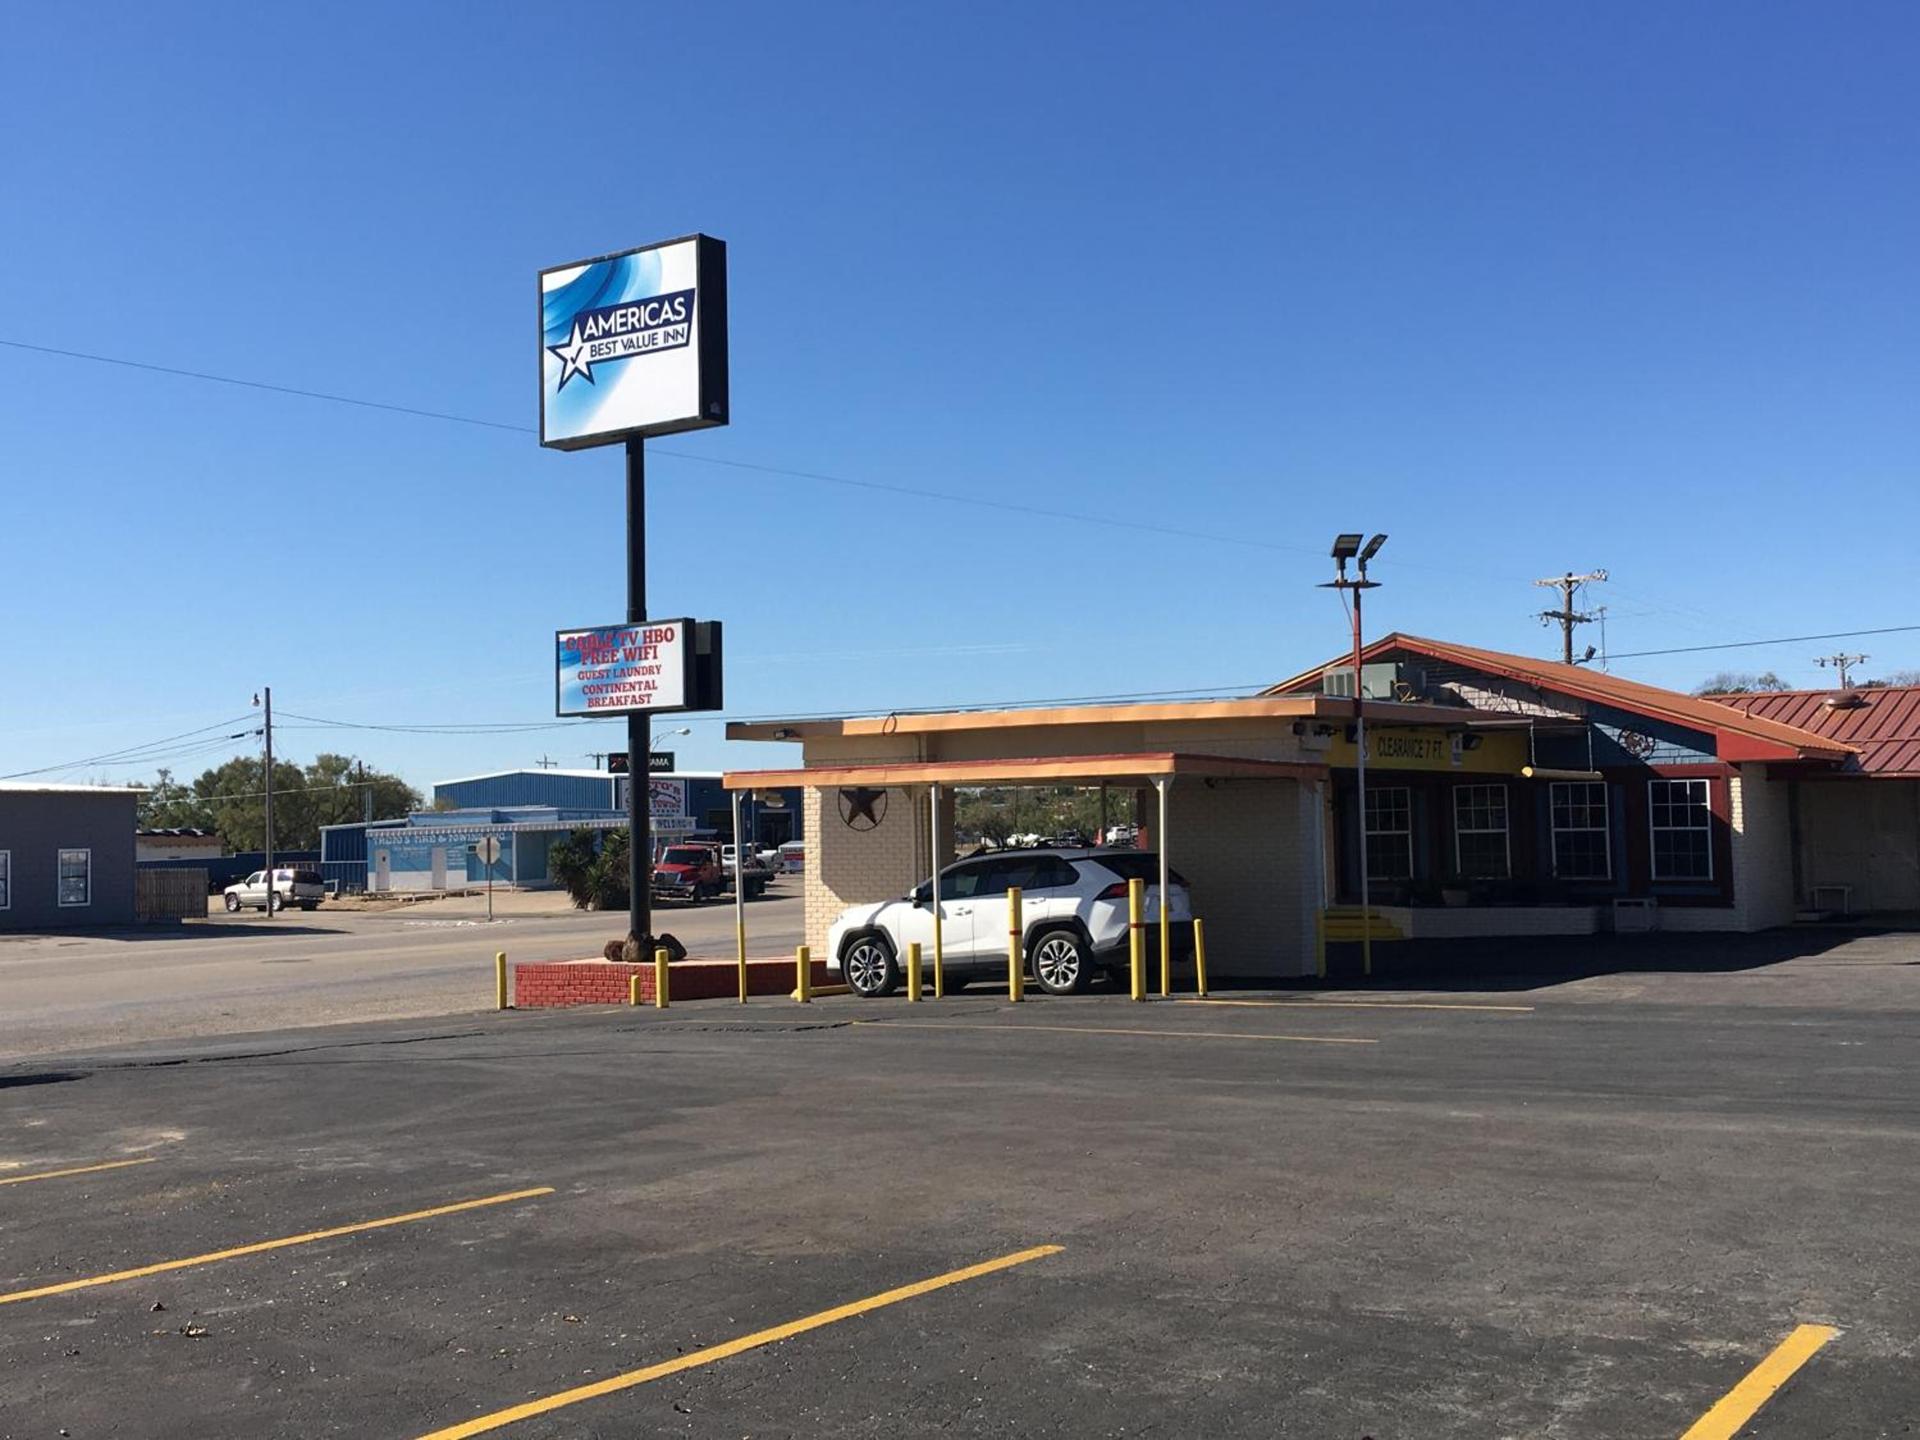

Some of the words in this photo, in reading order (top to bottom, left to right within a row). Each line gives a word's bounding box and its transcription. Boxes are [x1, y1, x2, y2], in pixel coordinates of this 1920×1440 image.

[583, 297, 686, 339] AMERICAS
[589, 340, 619, 358] BEST
[621, 332, 659, 351] VALUE
[663, 326, 686, 344] INN
[617, 630, 640, 646] TV
[642, 627, 675, 645] HBO
[581, 648, 620, 665] FREE
[622, 645, 658, 661] WIFI
[577, 669, 611, 681] GUEST
[613, 664, 662, 677] LAUNDRY
[582, 680, 658, 695] CONTINENTAL
[587, 694, 653, 708] BREAKFAST
[1377, 736, 1423, 758] CLEARANCE
